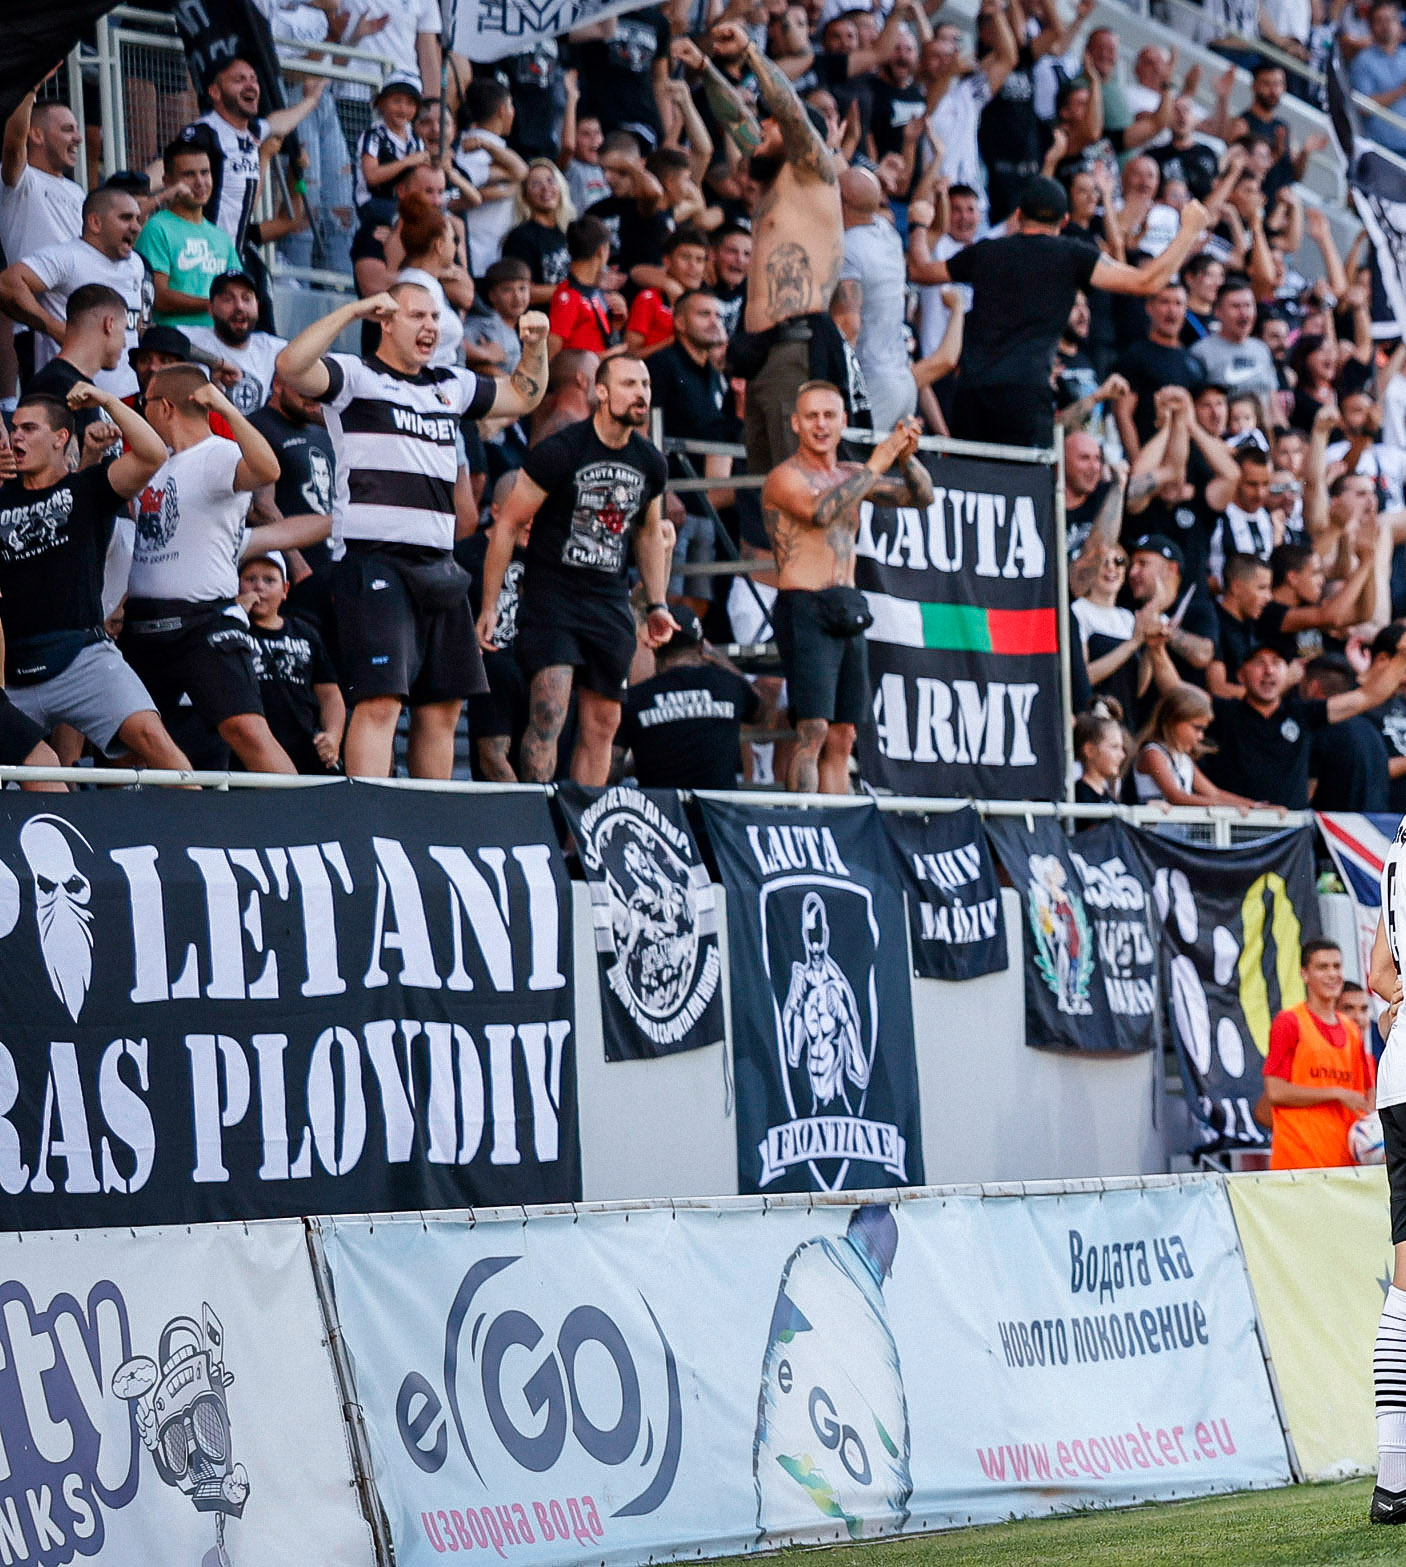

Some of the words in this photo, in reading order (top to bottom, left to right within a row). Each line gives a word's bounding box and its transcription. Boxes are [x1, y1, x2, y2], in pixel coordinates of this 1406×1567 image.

[393, 407, 456, 440] WINBET
[856, 486, 1047, 579] LAUTA
[873, 672, 1040, 766] ARMY
[745, 824, 851, 877] LAUTA
[186, 1019, 571, 1184] PLOVDIV
[1068, 1229, 1152, 1304] Водата
[1153, 1235, 1194, 1281] на
[998, 1318, 1069, 1368] новото
[1071, 1300, 1209, 1363] поколение
[0, 1298, 133, 1492] ty
[420, 1503, 536, 1559] изворна
[532, 1495, 605, 1548] вода
